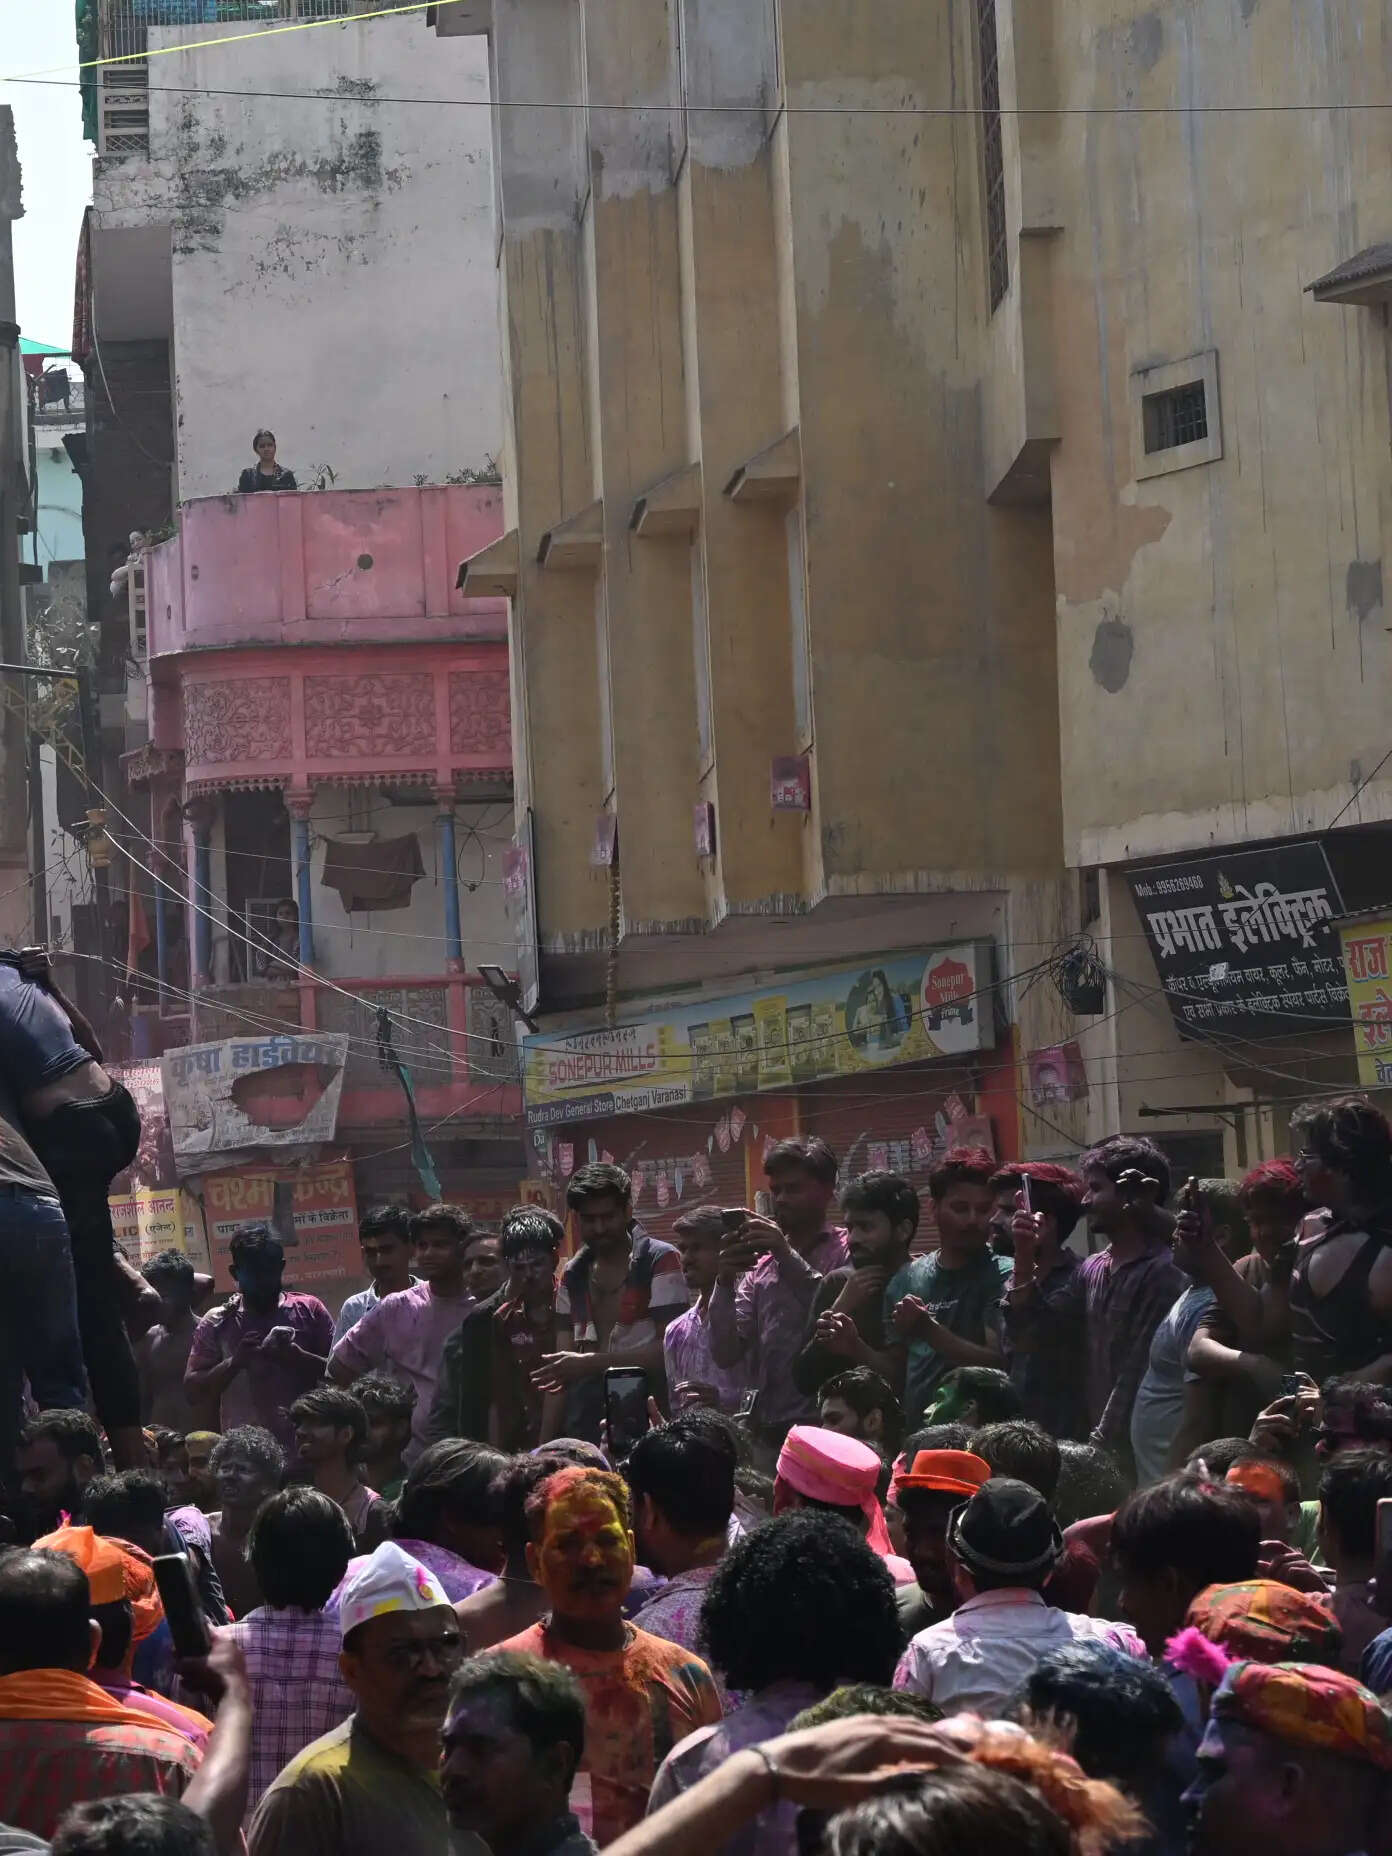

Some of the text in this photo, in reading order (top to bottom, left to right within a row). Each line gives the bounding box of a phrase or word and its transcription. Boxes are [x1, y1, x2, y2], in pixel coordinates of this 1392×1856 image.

[1146, 905, 1222, 958] प्रभात
[931, 973, 965, 991] Sonepur
[548, 1051, 612, 1086] SONEPUR
[614, 1042, 656, 1073] MILLS
[528, 1109, 549, 1124] Rudra
[550, 1106, 564, 1120] Dev
[565, 1102, 593, 1116] General
[615, 1093, 651, 1111] Chetganj
[652, 1084, 687, 1105] Varanasi
